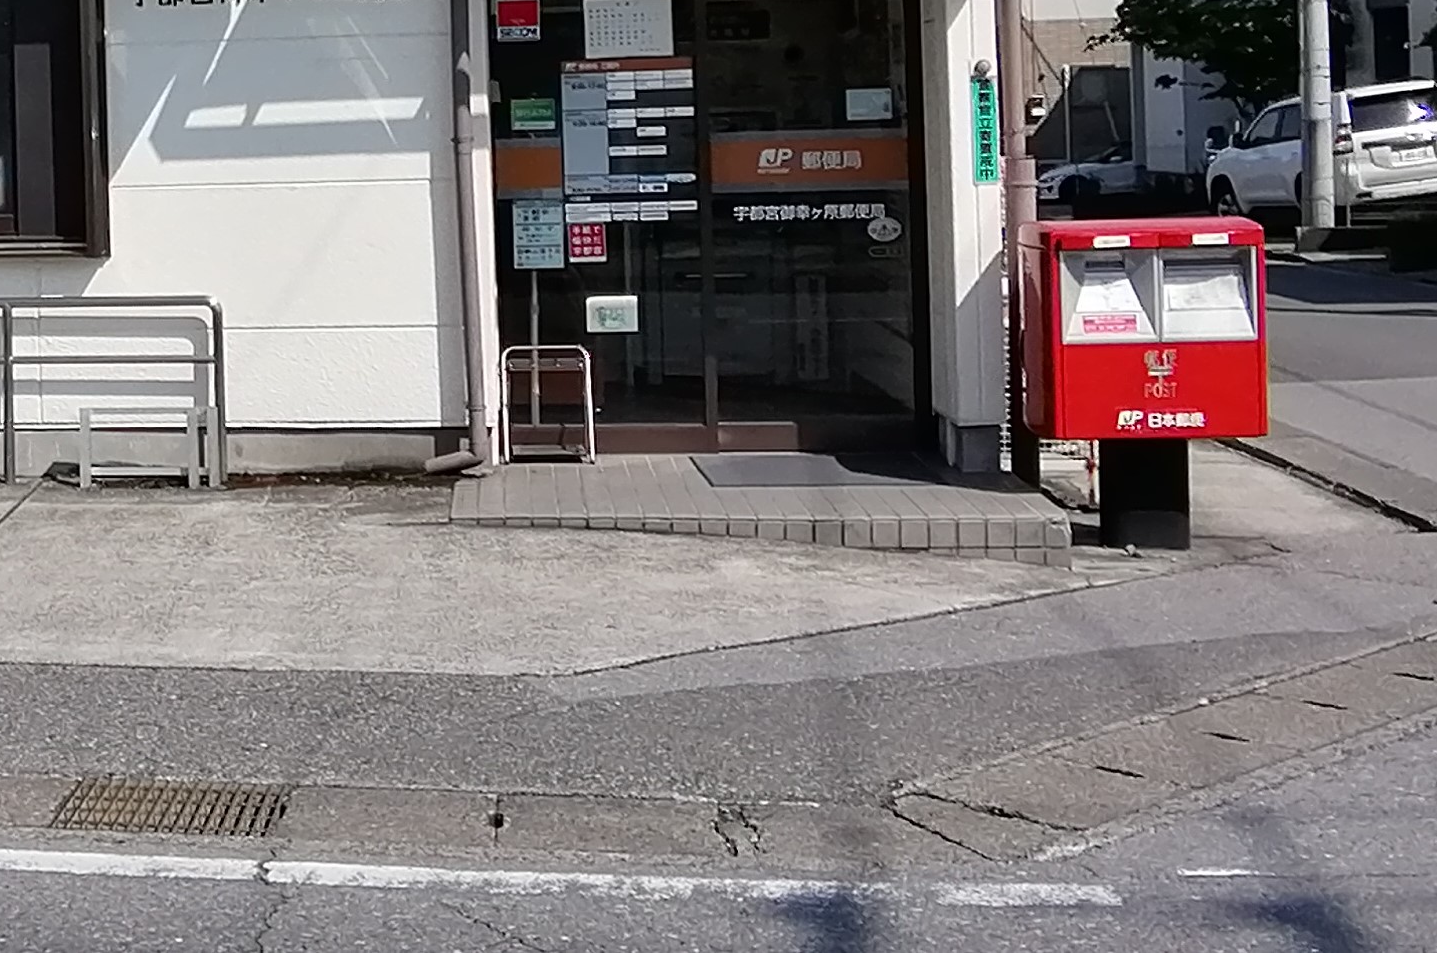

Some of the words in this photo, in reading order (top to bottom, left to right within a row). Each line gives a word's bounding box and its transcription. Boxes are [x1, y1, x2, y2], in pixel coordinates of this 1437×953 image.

[802, 150, 862, 170] 郵便局
[1144, 382, 1178, 398] POST
